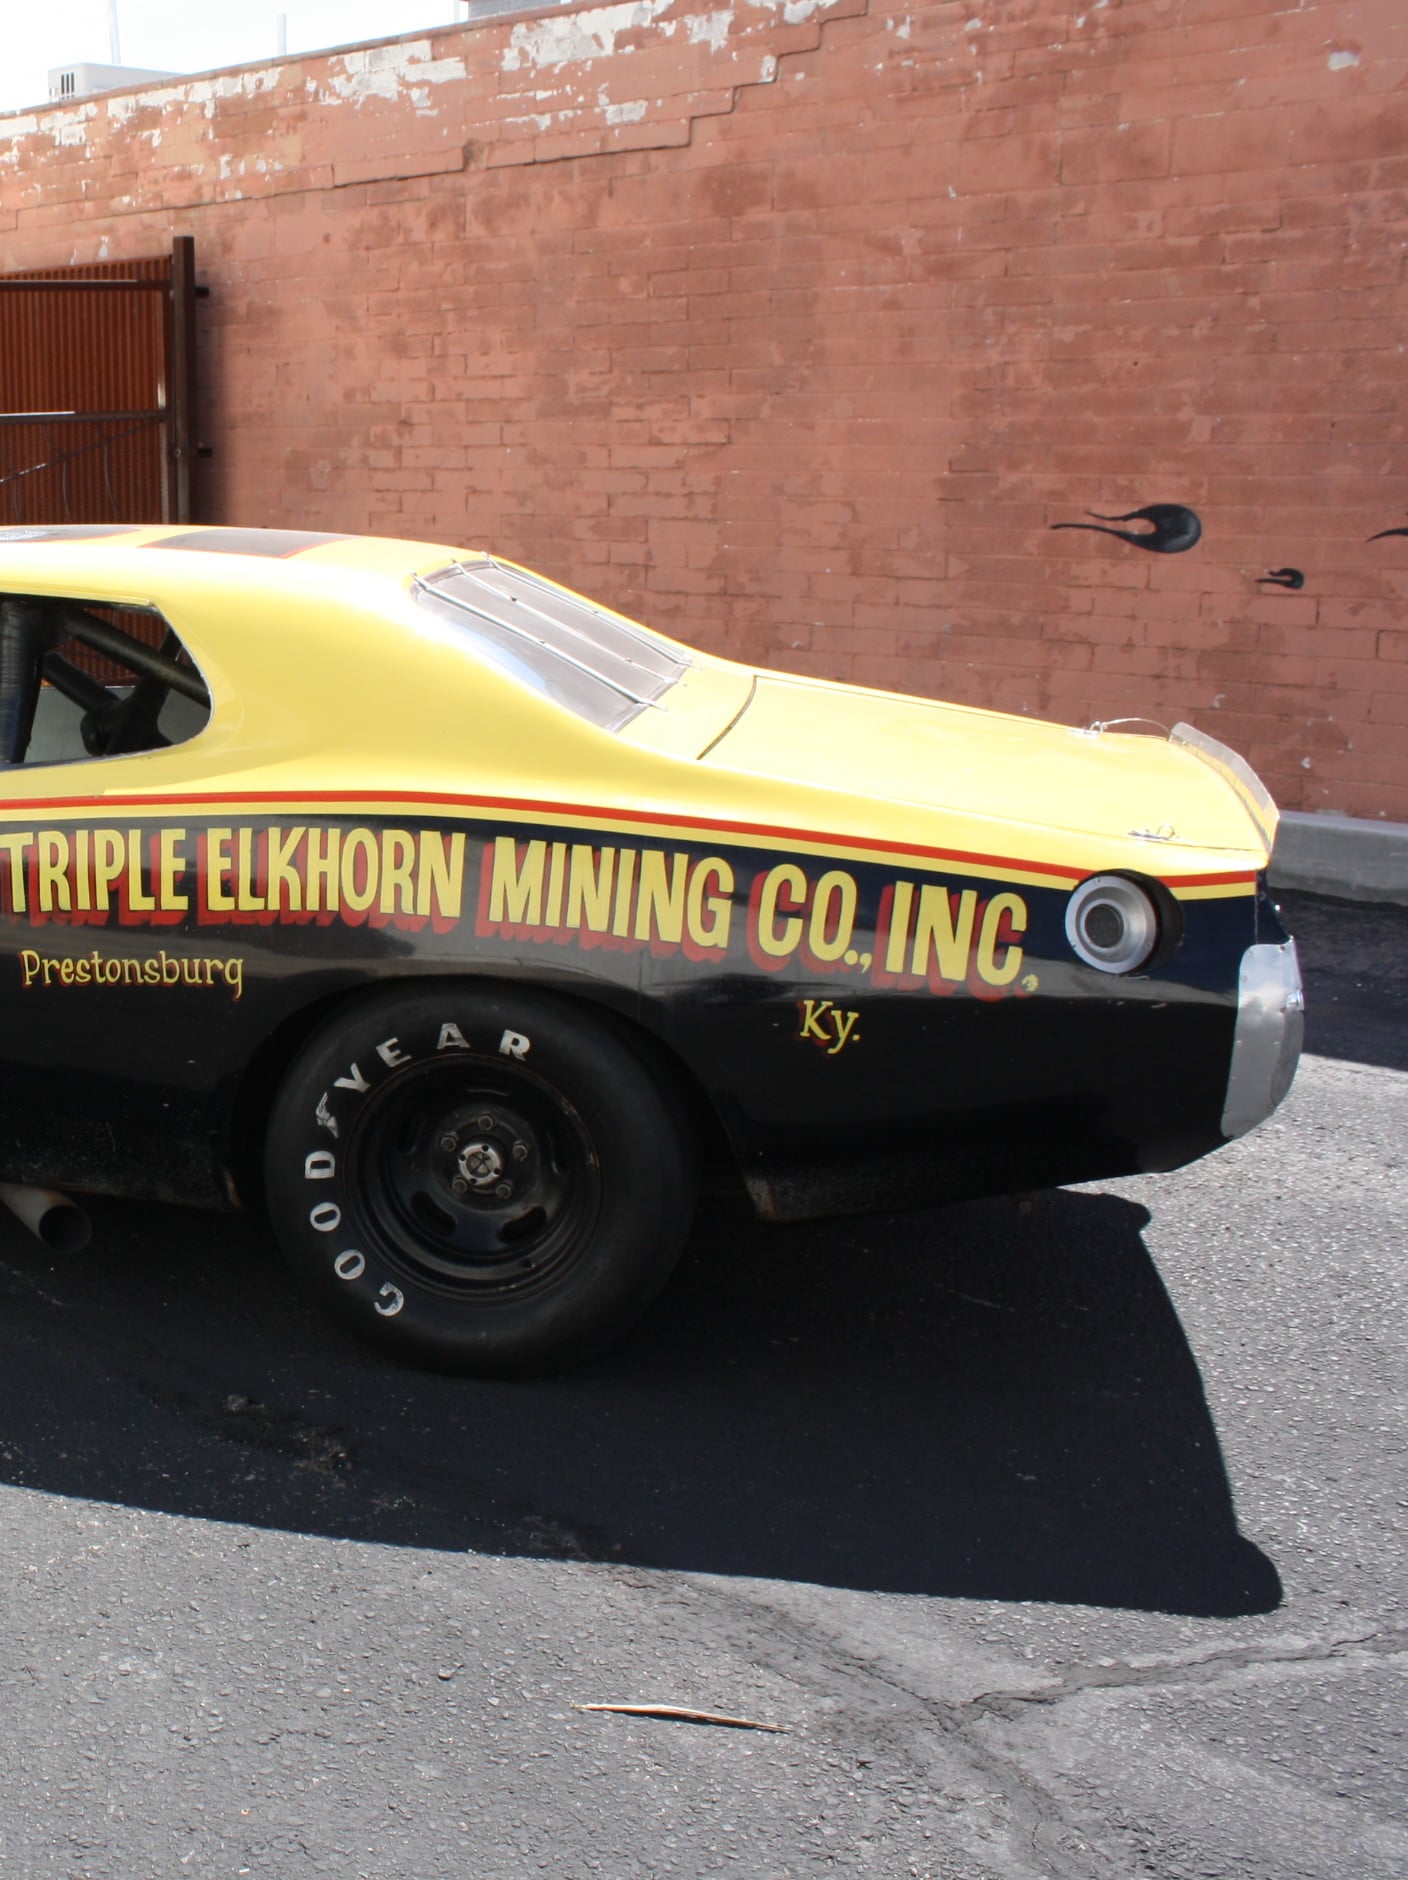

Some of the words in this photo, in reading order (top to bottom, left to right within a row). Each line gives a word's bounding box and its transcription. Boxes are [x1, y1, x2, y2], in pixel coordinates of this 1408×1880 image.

[206, 826, 466, 919] ELKHORN
[489, 836, 735, 949] MINING
[885, 880, 1040, 993] INC.
[20, 949, 245, 1002] Prestonsburg
[799, 999, 863, 1054] Ky.
[303, 1021, 531, 1317] GOODYEAR
